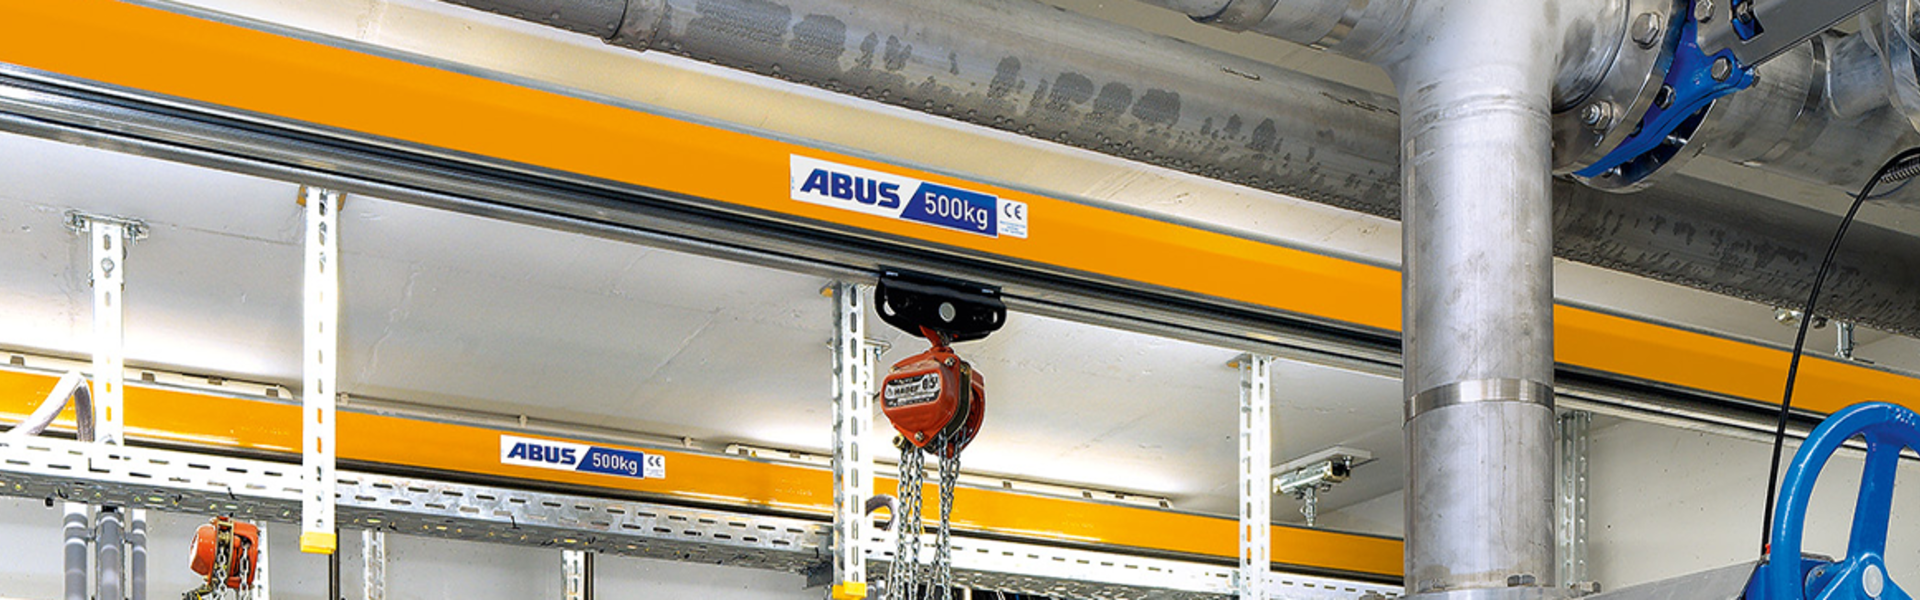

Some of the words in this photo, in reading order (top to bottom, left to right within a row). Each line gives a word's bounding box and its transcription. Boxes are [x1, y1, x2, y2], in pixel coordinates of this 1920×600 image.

[800, 168, 901, 209] ABUS
[924, 192, 988, 231] 500kg
[1004, 202, 1022, 220] CE
[507, 442, 576, 465] ABUS
[592, 452, 638, 475] 500kg
